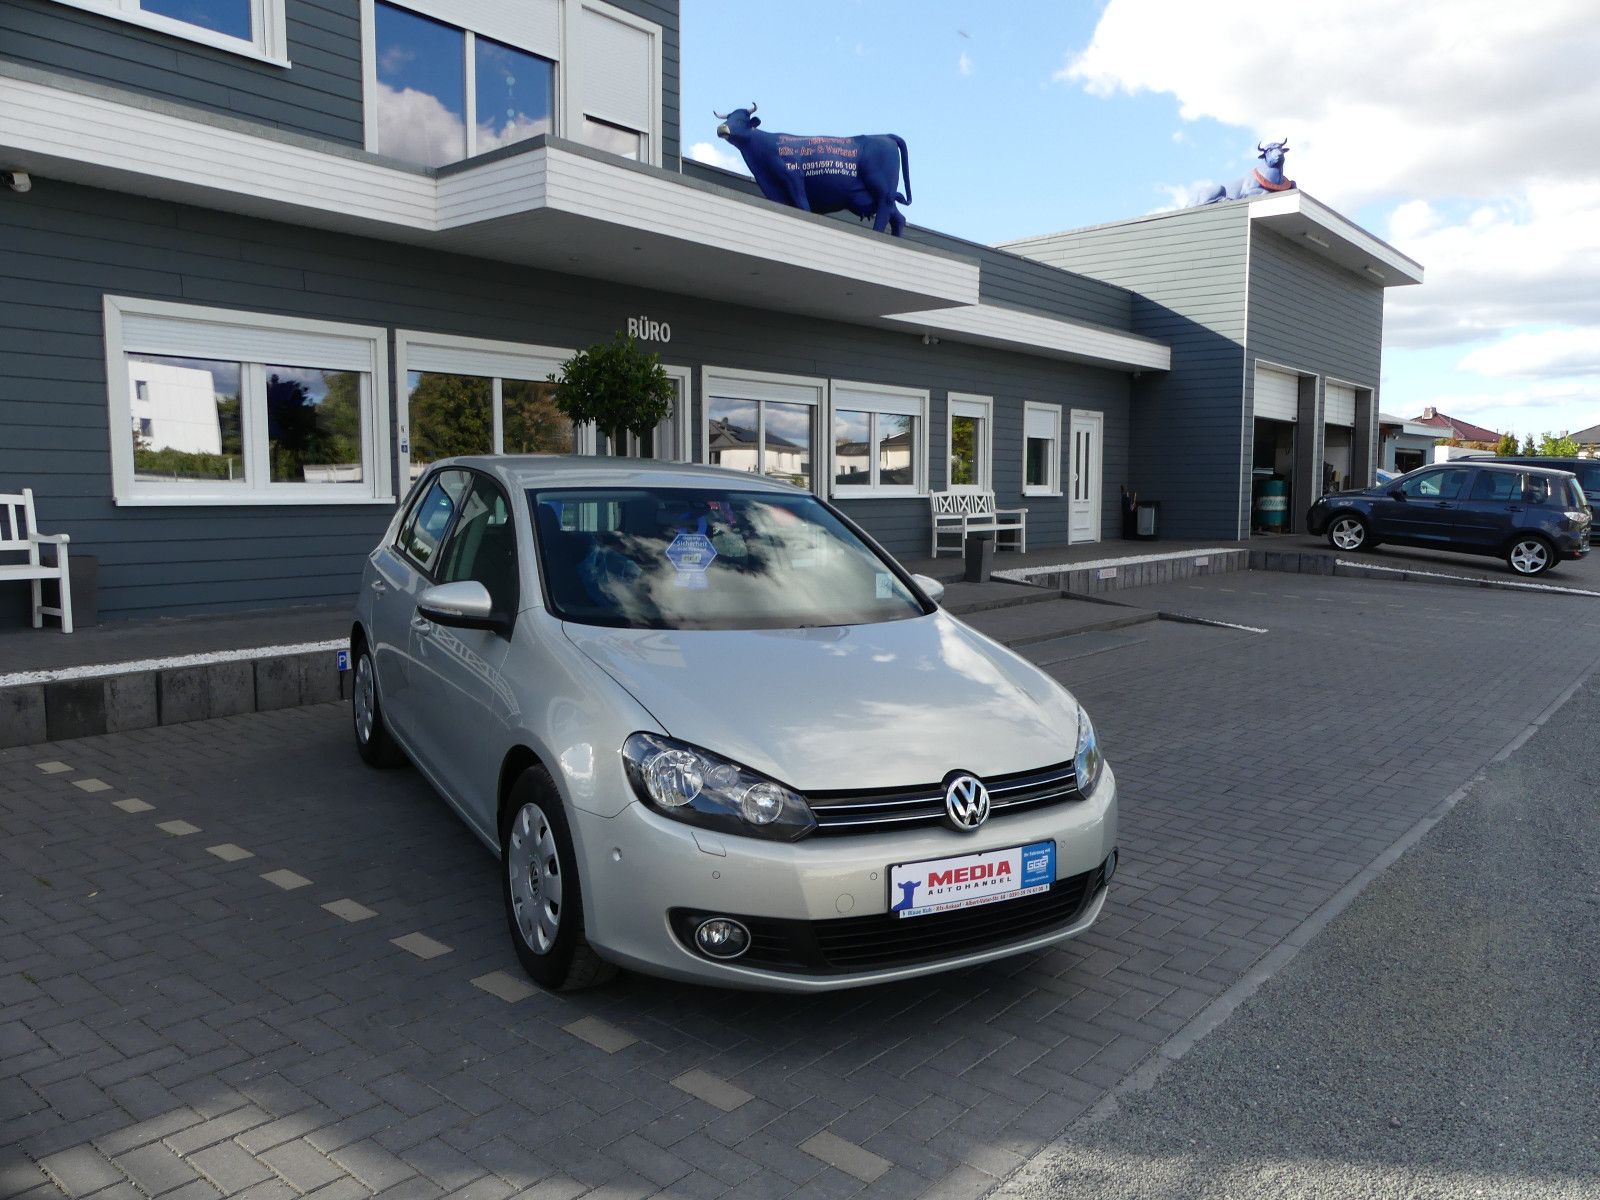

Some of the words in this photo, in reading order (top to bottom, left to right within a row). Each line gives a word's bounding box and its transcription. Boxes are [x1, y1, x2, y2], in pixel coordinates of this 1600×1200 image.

[786, 162, 800, 171] Tel.
[802, 160, 834, 171] 0391/597
[845, 162, 857, 171] 100
[627, 315, 671, 343] BÜRO
[928, 860, 1011, 888] MEDIA
[928, 876, 1012, 896] AUTOHANDEL
